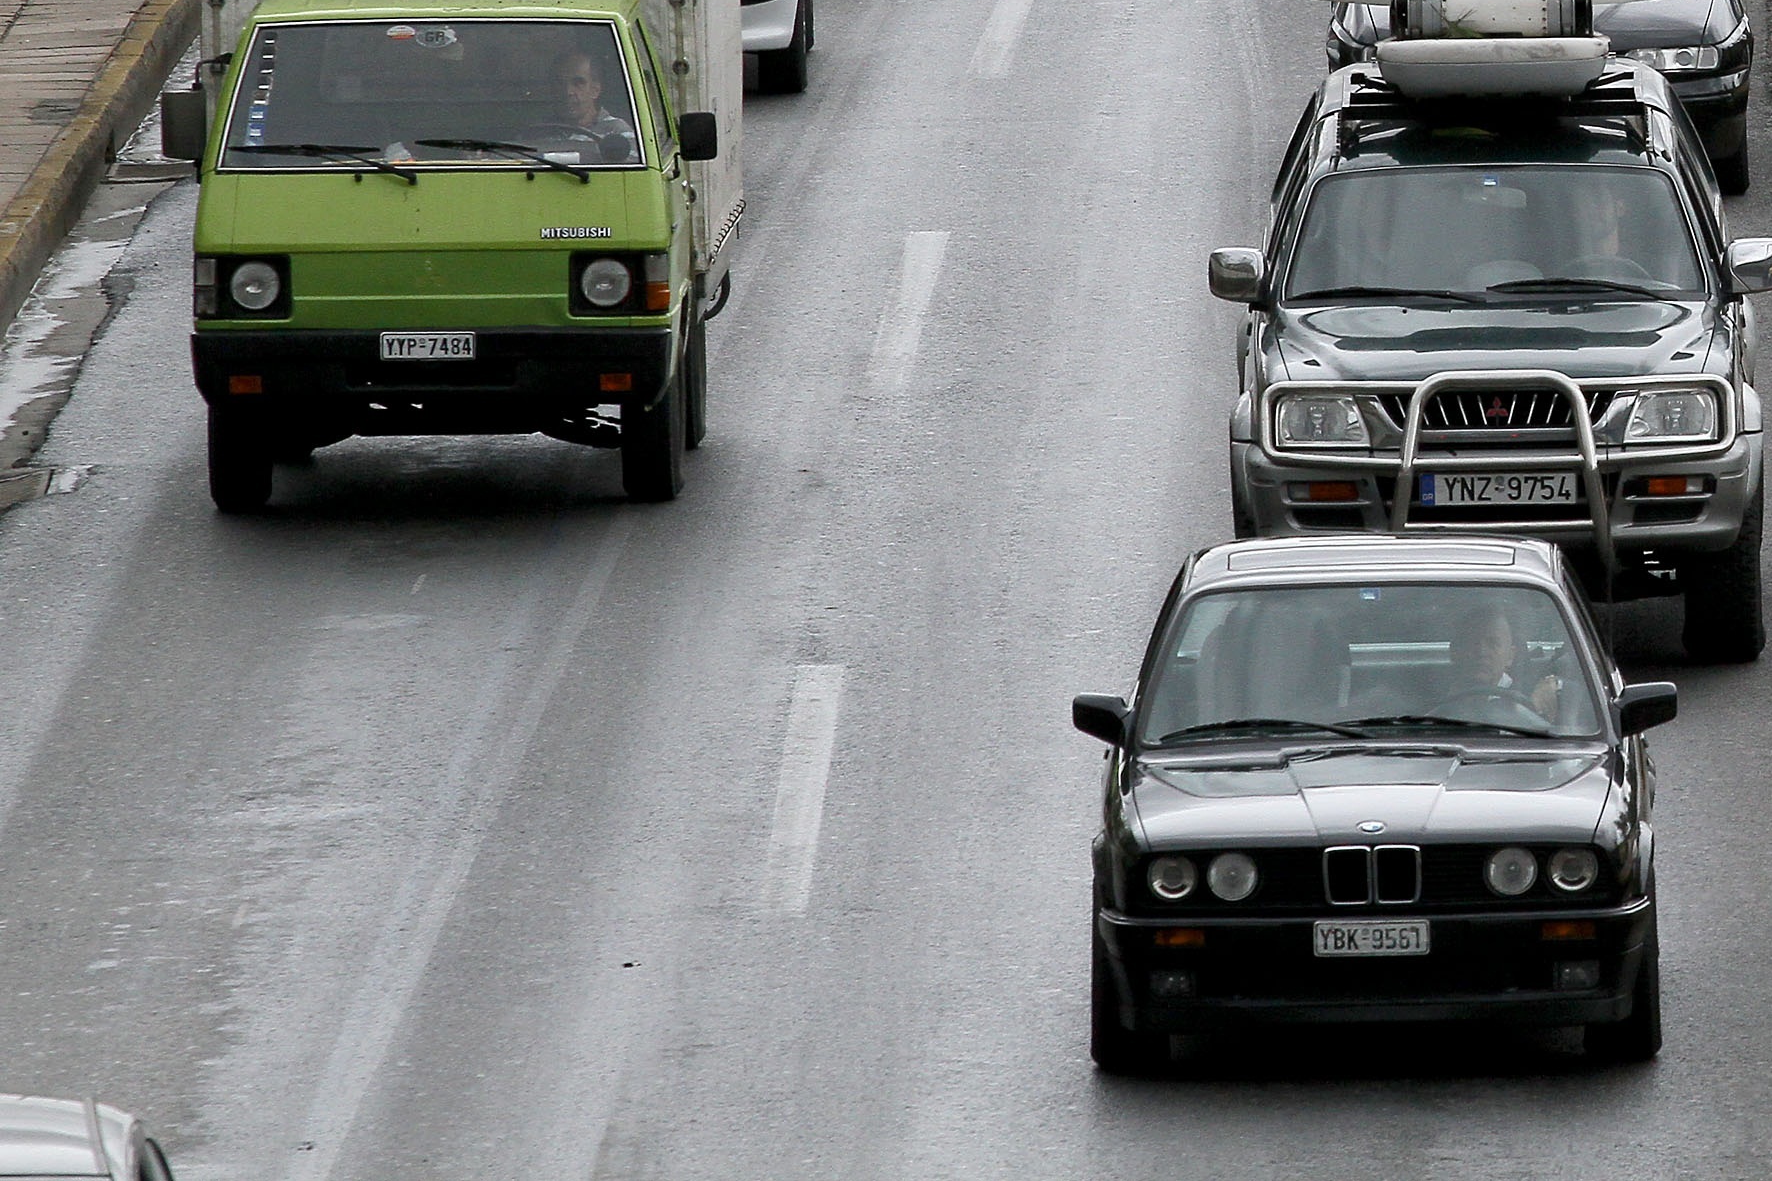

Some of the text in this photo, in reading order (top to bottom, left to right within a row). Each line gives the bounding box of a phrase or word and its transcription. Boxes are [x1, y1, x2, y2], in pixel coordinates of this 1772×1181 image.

[540, 227, 611, 238] MITSUBISHI
[385, 337, 472, 356] YYP-7484
[1444, 476, 1571, 501] YNZ-9754
